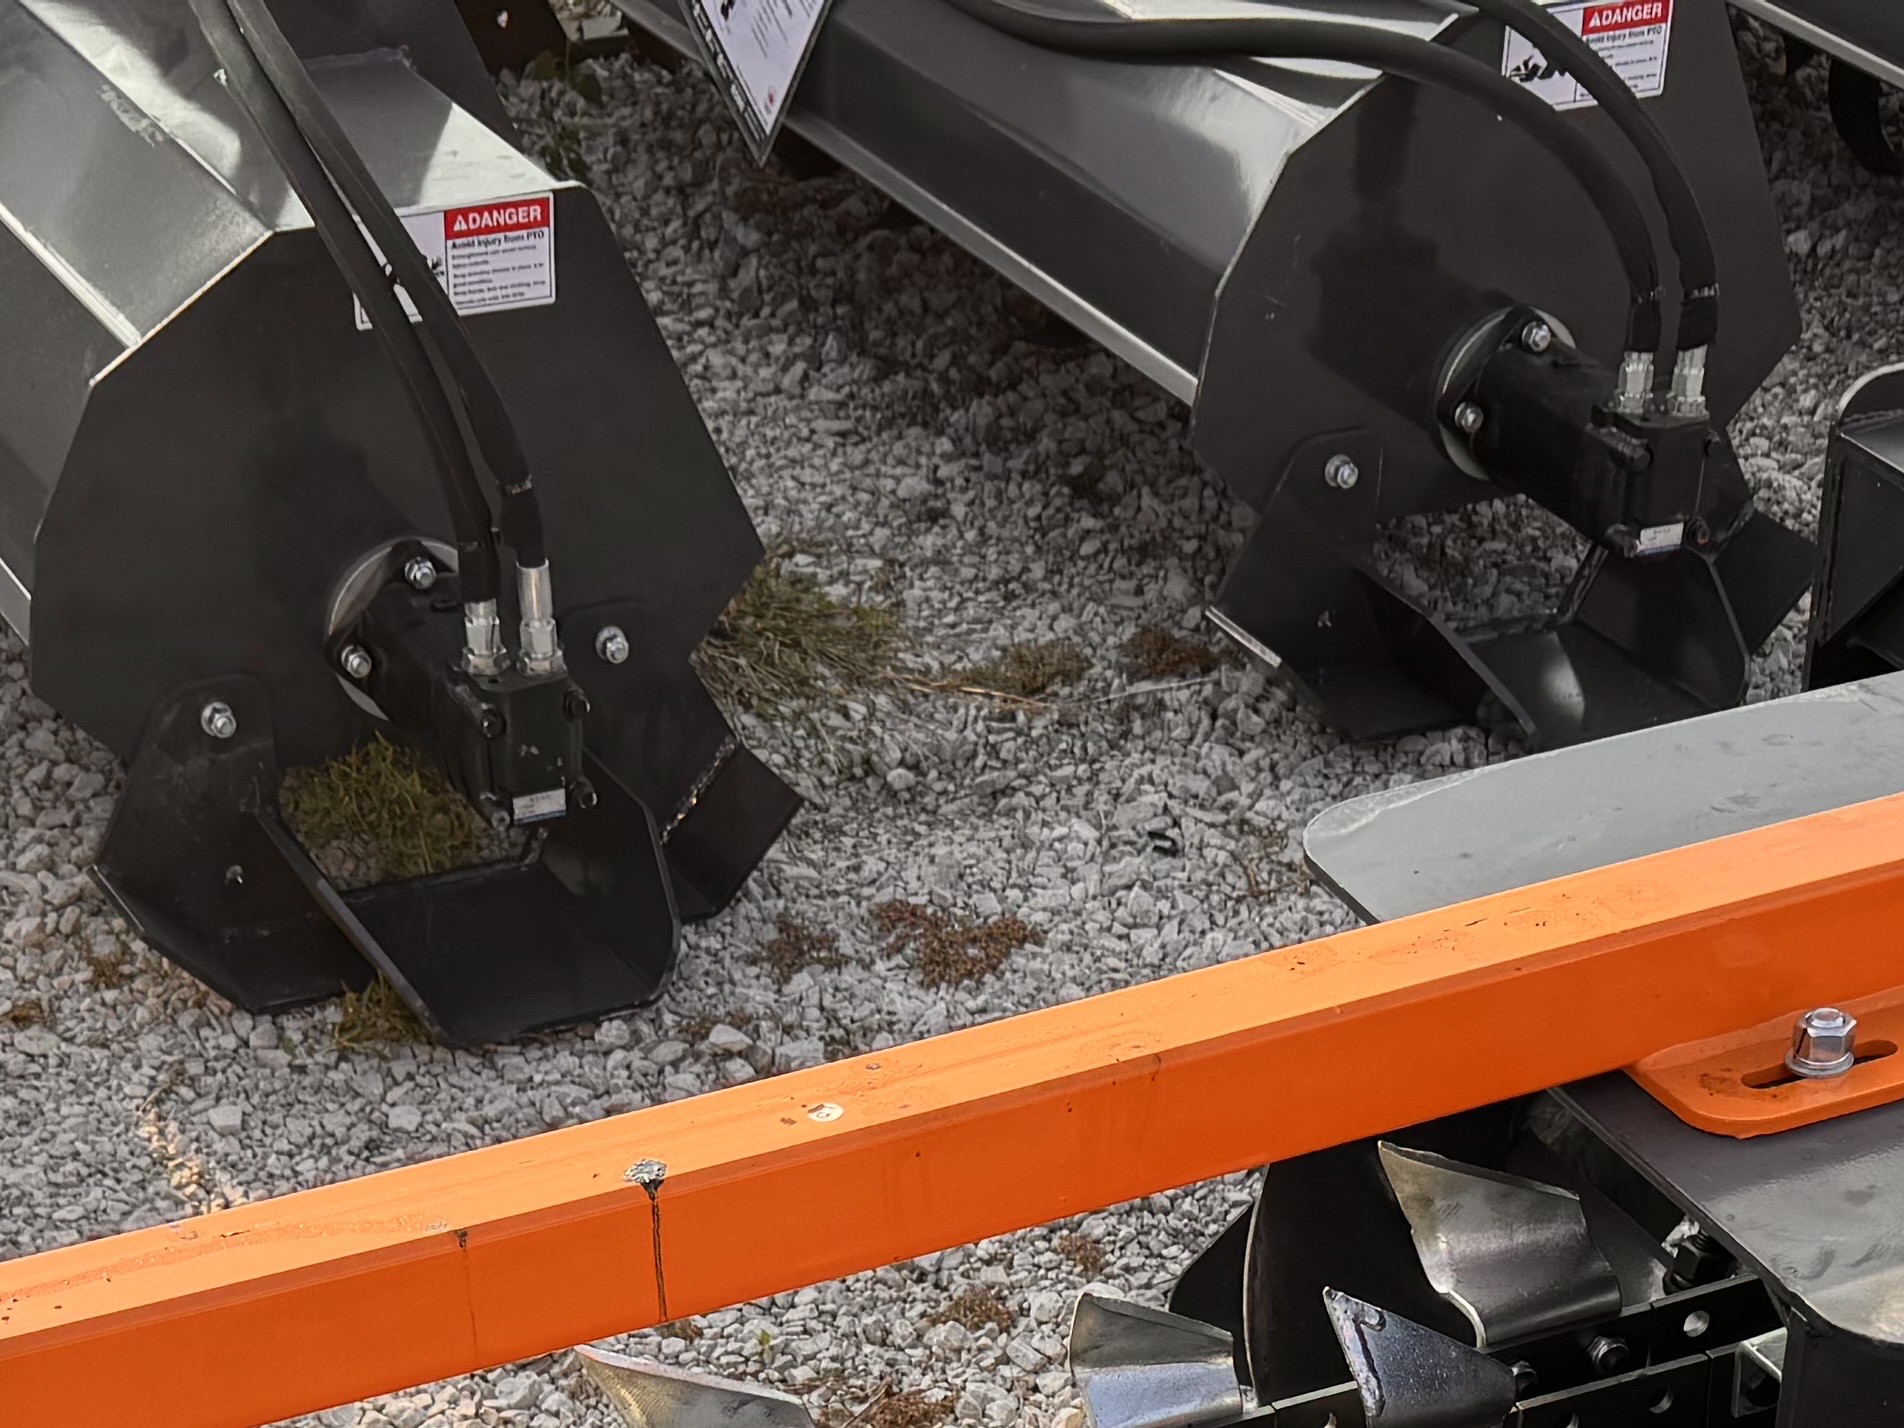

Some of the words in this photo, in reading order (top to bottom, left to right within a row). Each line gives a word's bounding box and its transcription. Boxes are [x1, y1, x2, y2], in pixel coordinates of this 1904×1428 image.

[1601, 2, 1663, 26] DANGER
[468, 204, 542, 230] DANGER
[526, 229, 545, 241] PTO
